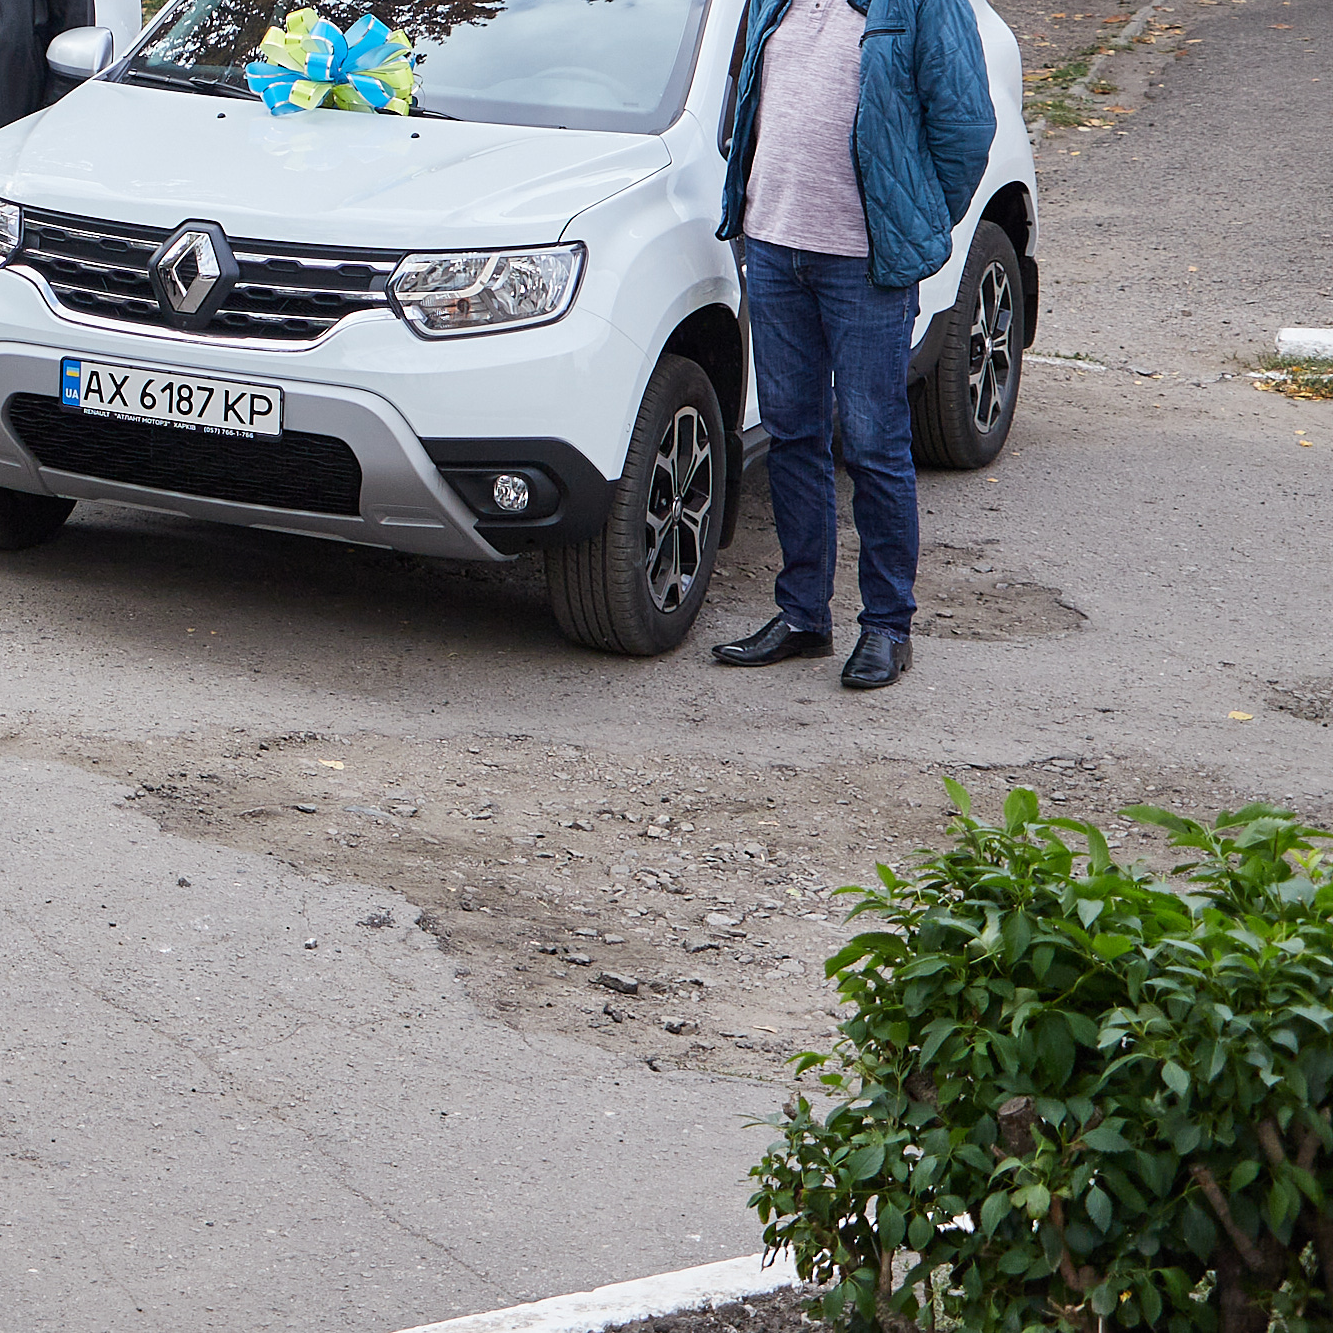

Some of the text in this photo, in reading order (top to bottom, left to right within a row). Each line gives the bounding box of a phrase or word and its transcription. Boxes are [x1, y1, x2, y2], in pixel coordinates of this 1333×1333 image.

[65, 387, 79, 400] UA
[83, 370, 273, 426] AX 6187 KP
[83, 408, 110, 418] RENAULT
